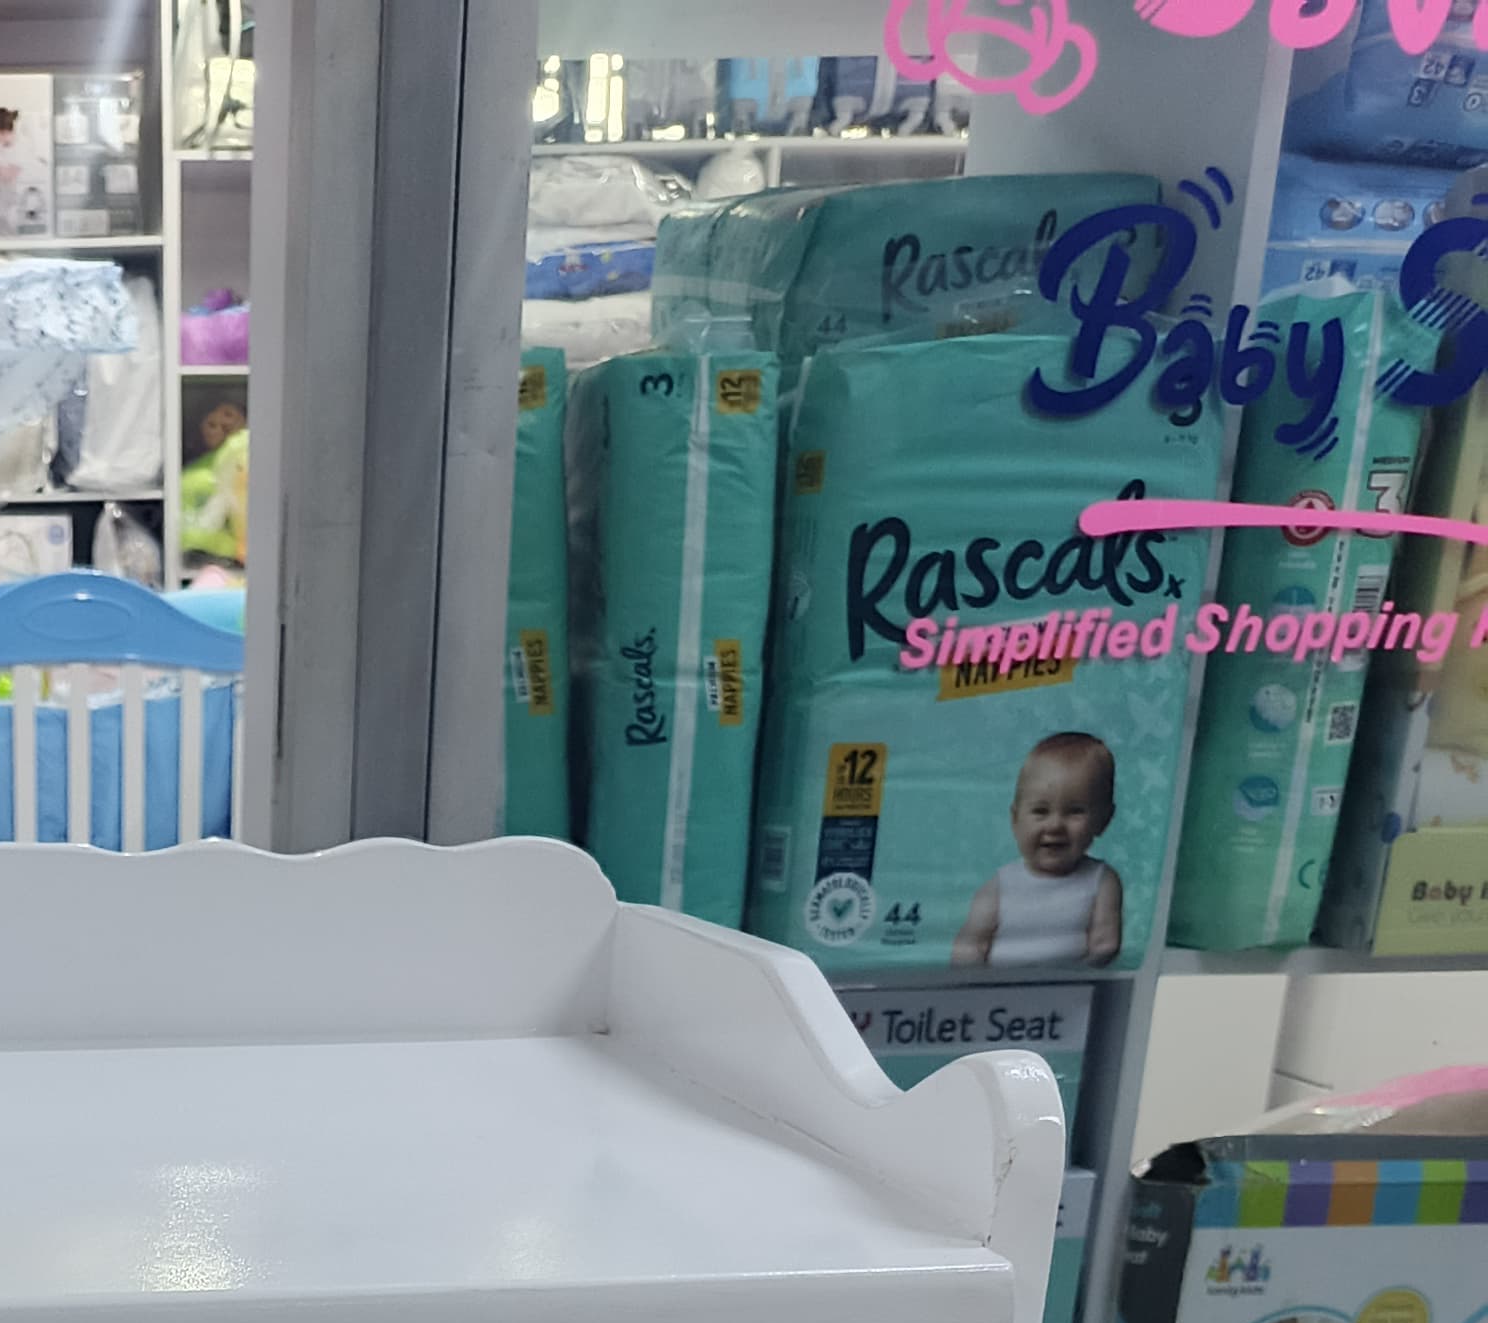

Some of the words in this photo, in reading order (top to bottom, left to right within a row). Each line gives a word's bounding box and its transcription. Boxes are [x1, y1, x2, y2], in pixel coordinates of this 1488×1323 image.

[881, 208, 1059, 324] Rascal
[816, 314, 848, 335] 44
[1026, 202, 1346, 448] Baby
[641, 372, 675, 397] 3
[721, 374, 747, 406] 12
[847, 478, 1175, 663] Rascals
[899, 603, 1179, 676] Simplified
[1184, 600, 1460, 664] Shopping
[526, 638, 548, 705] NAPPIES
[720, 648, 738, 716] NAPPIES
[843, 749, 878, 785] 12
[1412, 880, 1474, 907] Baby
[882, 902, 922, 926] 44
[882, 1006, 976, 1045] Toilet
[985, 1007, 1064, 1043] Seat
